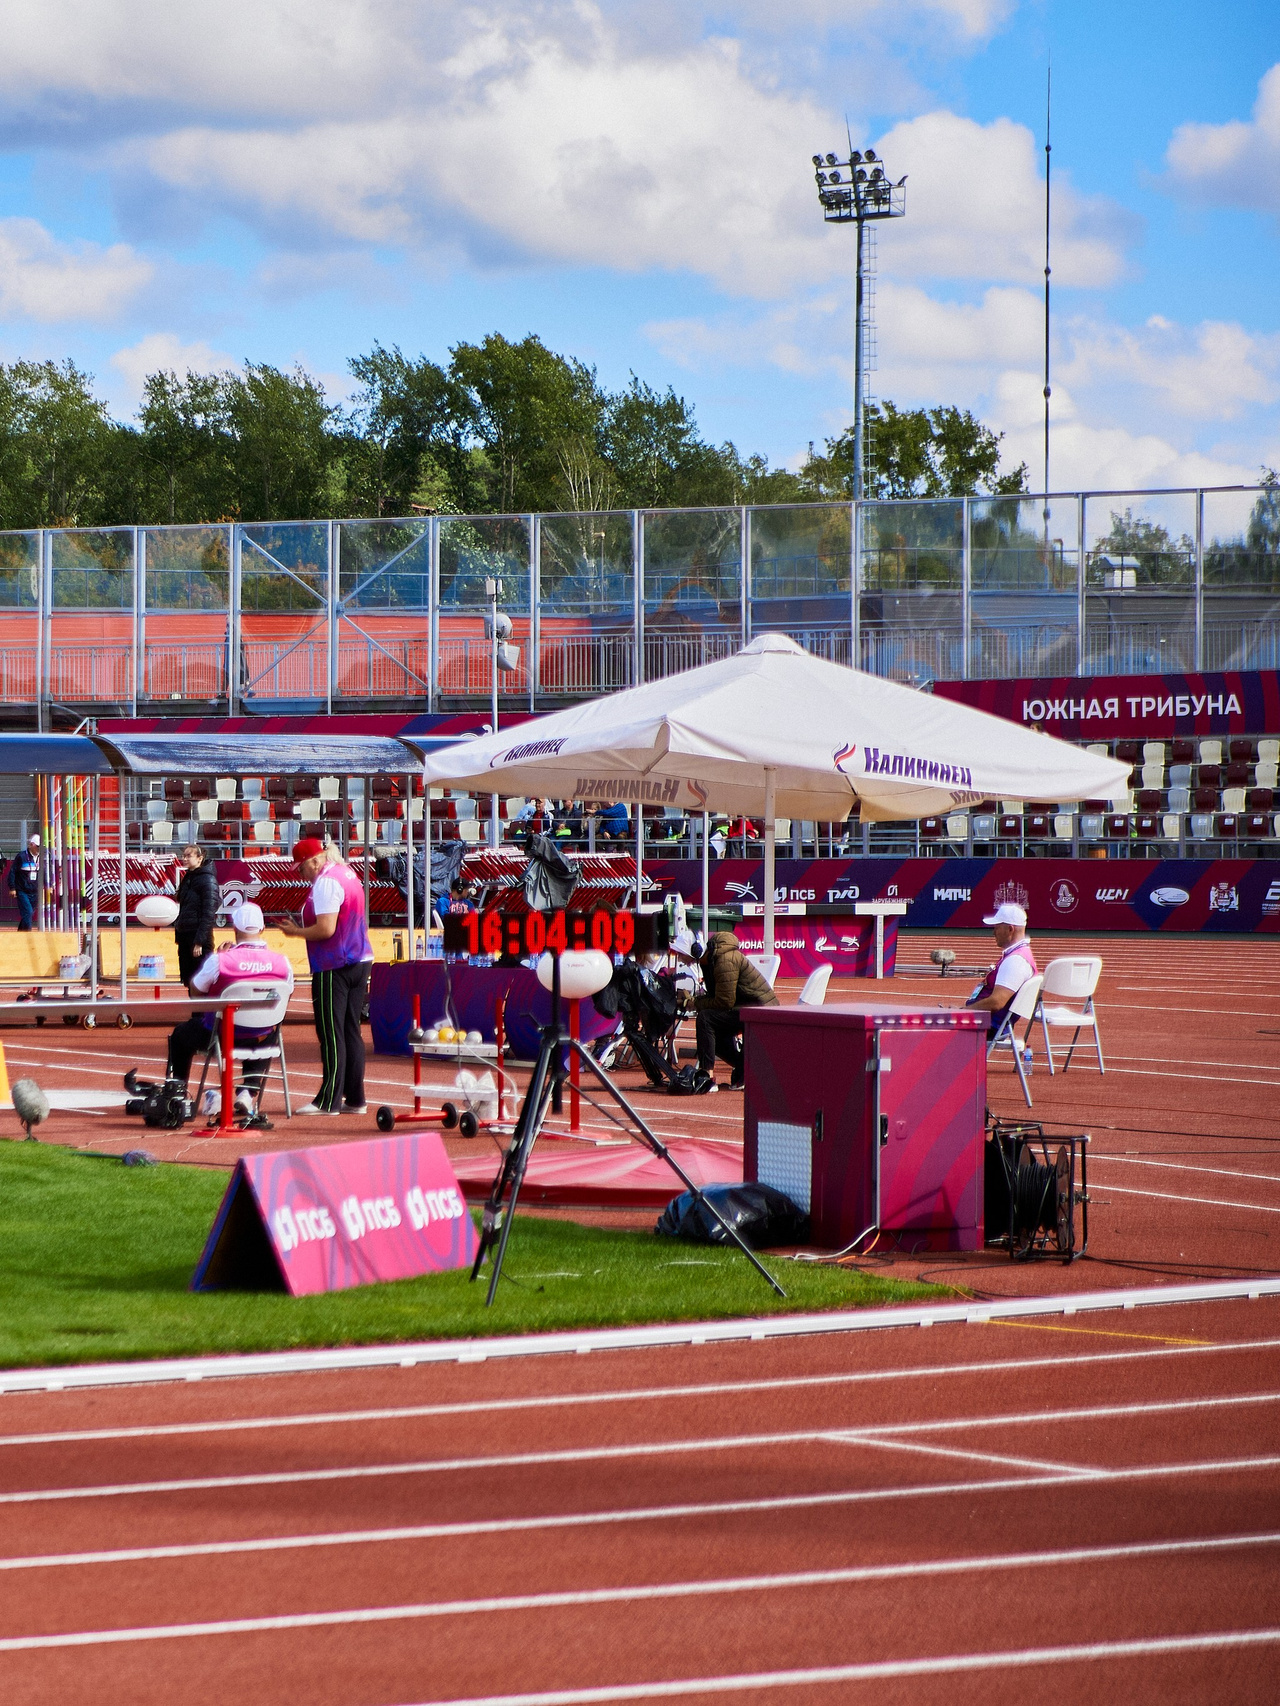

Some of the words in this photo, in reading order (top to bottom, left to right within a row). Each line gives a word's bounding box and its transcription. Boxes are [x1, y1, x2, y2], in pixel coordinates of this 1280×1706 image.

[1022, 697, 1119, 721] ЮЖНАЯ
[1126, 693, 1243, 718] ТРИБУНА
[790, 889, 816, 901] ПСБ
[933, 888, 972, 902] МАТЧ!
[461, 909, 635, 955] 16:04:09
[774, 940, 806, 950] ОССИИ
[239, 961, 273, 974] СУДЬЯ
[295, 1205, 337, 1242] ПСБ
[361, 1195, 402, 1232] ПСБ
[423, 1186, 465, 1221] ПСБ
